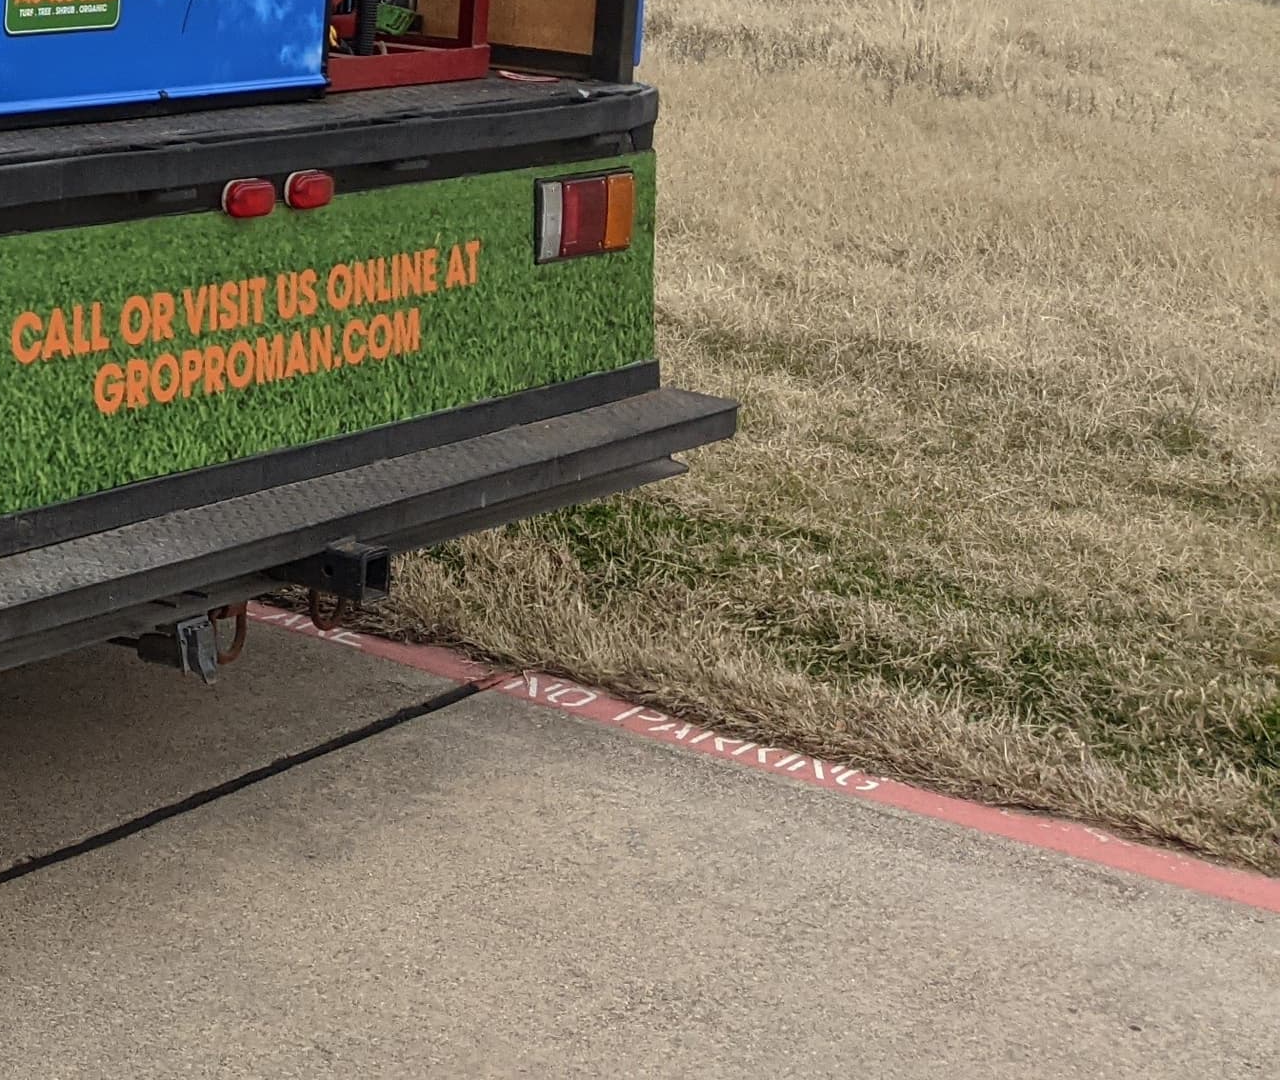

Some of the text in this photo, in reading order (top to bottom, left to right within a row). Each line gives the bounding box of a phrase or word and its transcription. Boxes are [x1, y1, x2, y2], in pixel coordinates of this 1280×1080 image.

[10, 239, 480, 365] CALL OR VISIT US ONLINE AT
[93, 307, 421, 415] GROPROMAN.COM
[503, 676, 881, 791] NO PARKING
